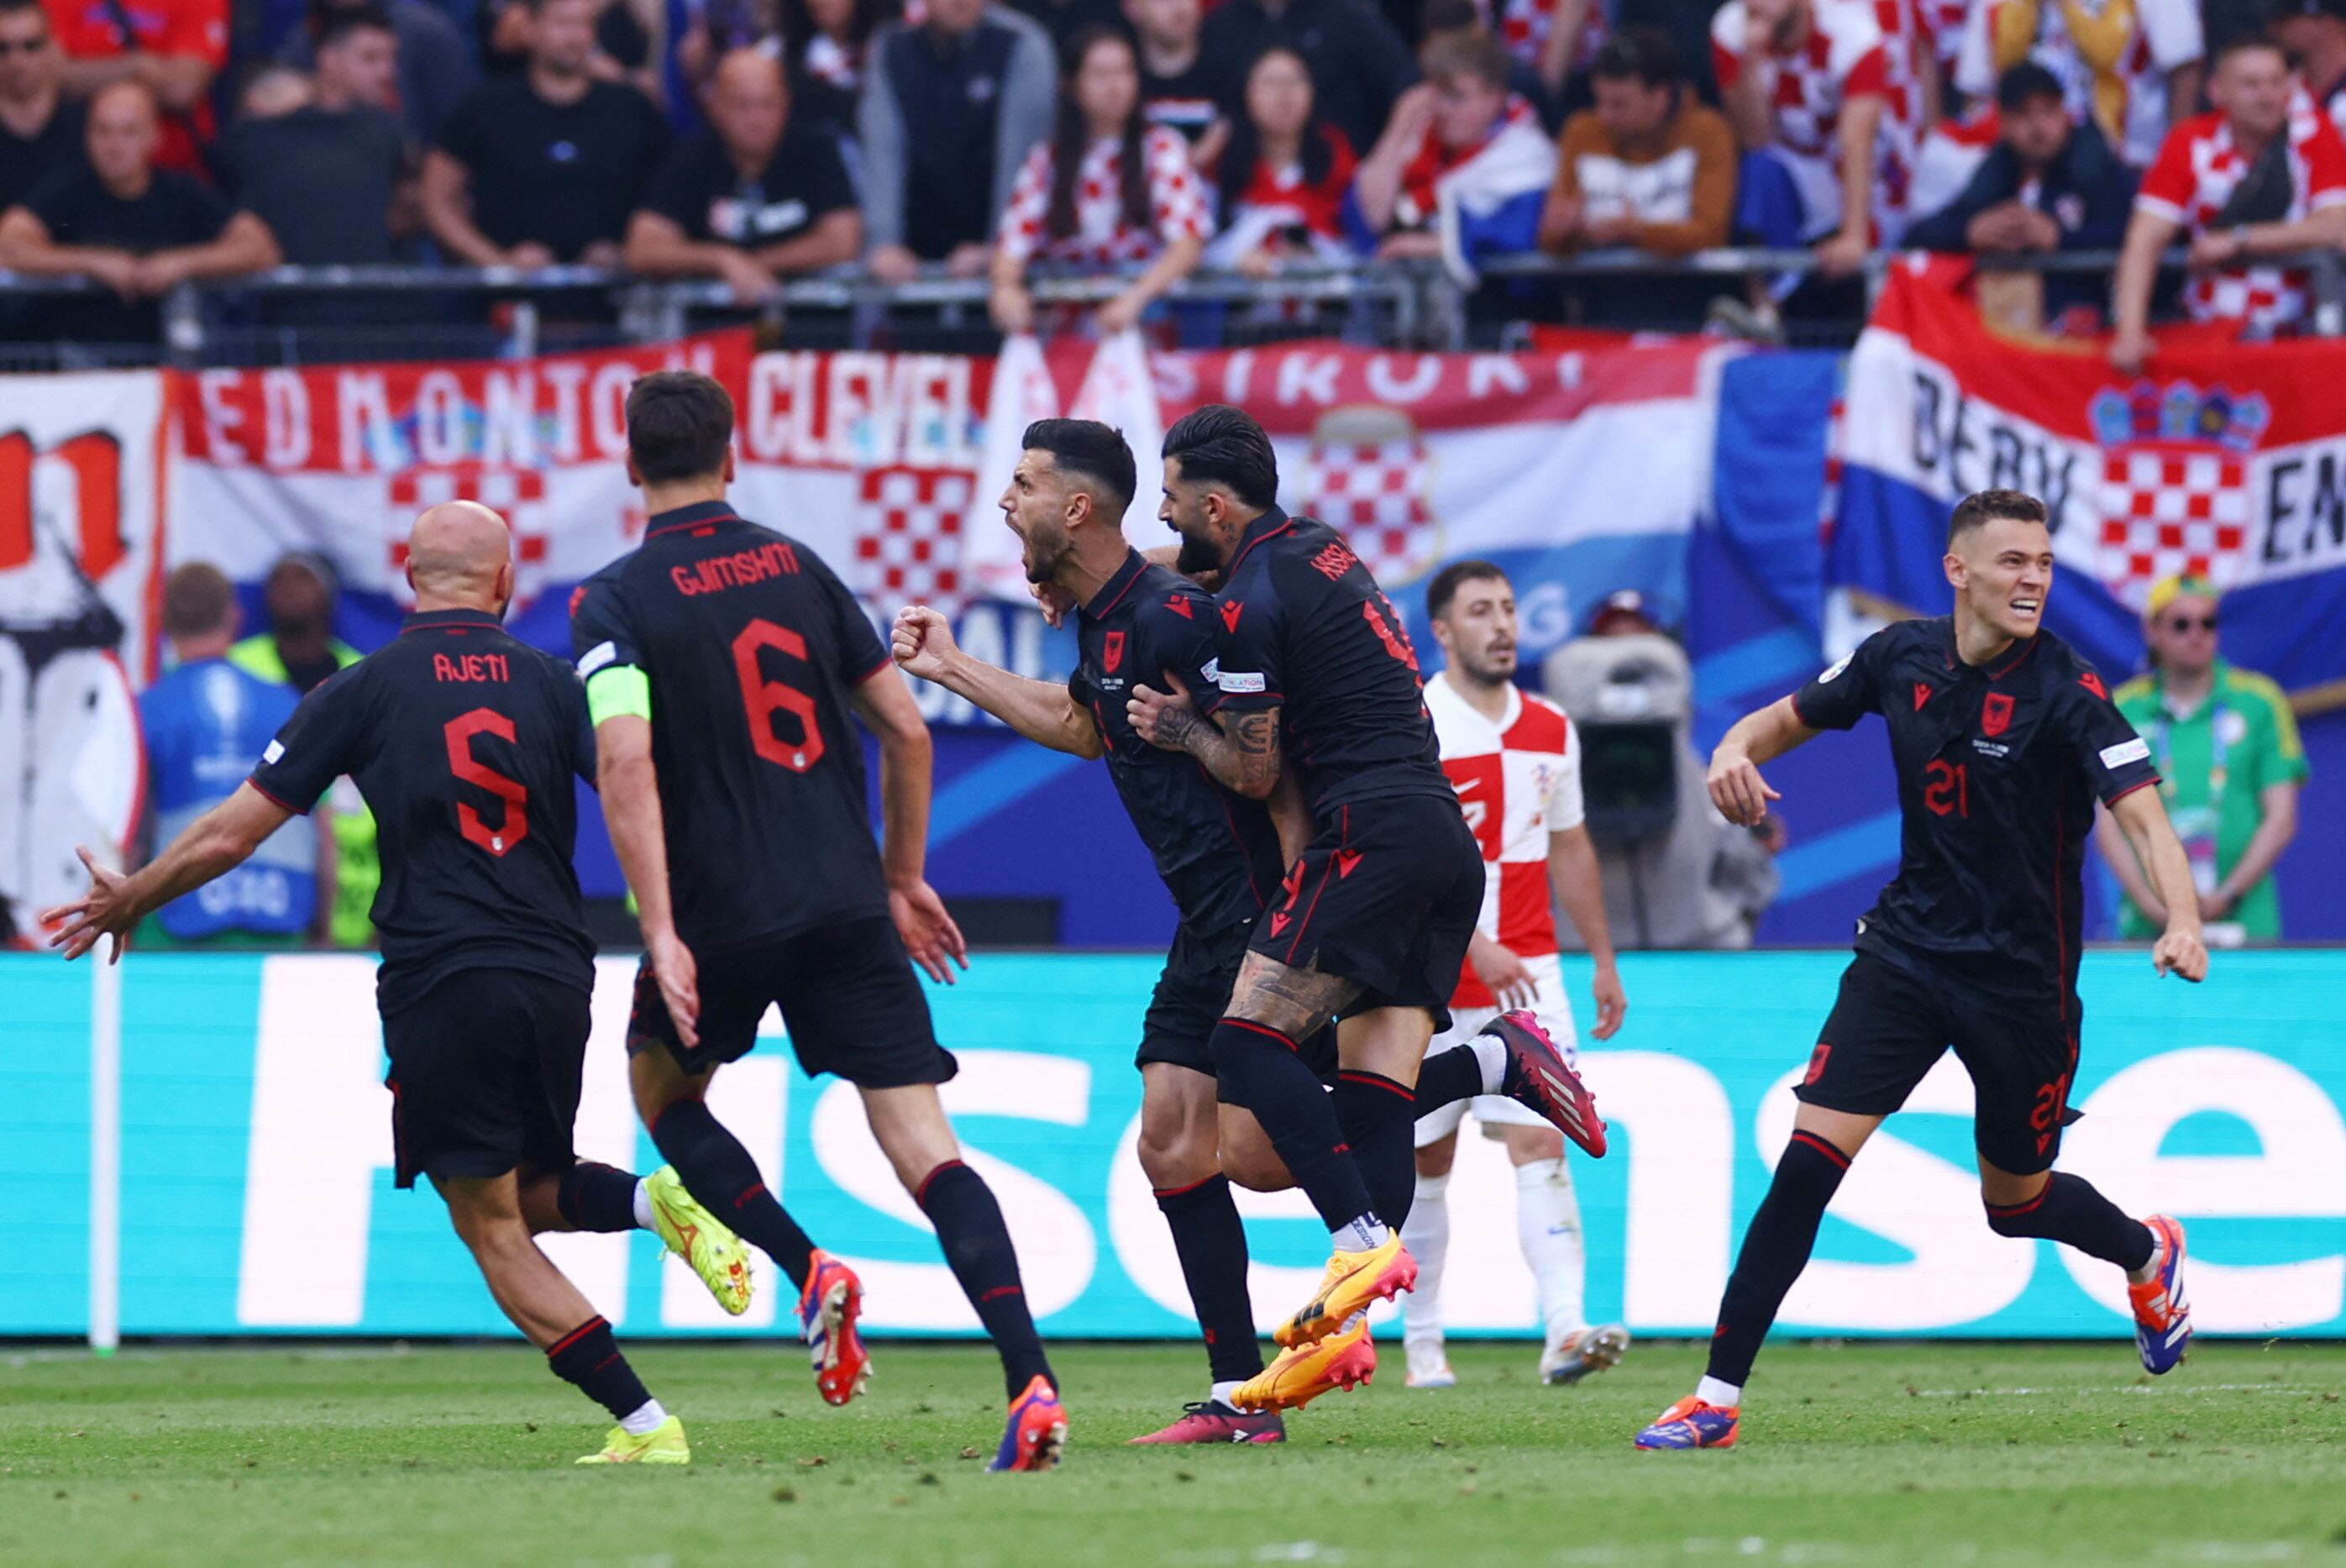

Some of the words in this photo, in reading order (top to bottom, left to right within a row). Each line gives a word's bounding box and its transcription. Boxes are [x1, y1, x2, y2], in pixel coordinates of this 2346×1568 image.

[433, 652, 511, 683] AJETI
[732, 617, 825, 774] 6
[443, 706, 529, 857] 5
[1924, 758, 1970, 819] 21
[2029, 1072, 2068, 1131] 21
